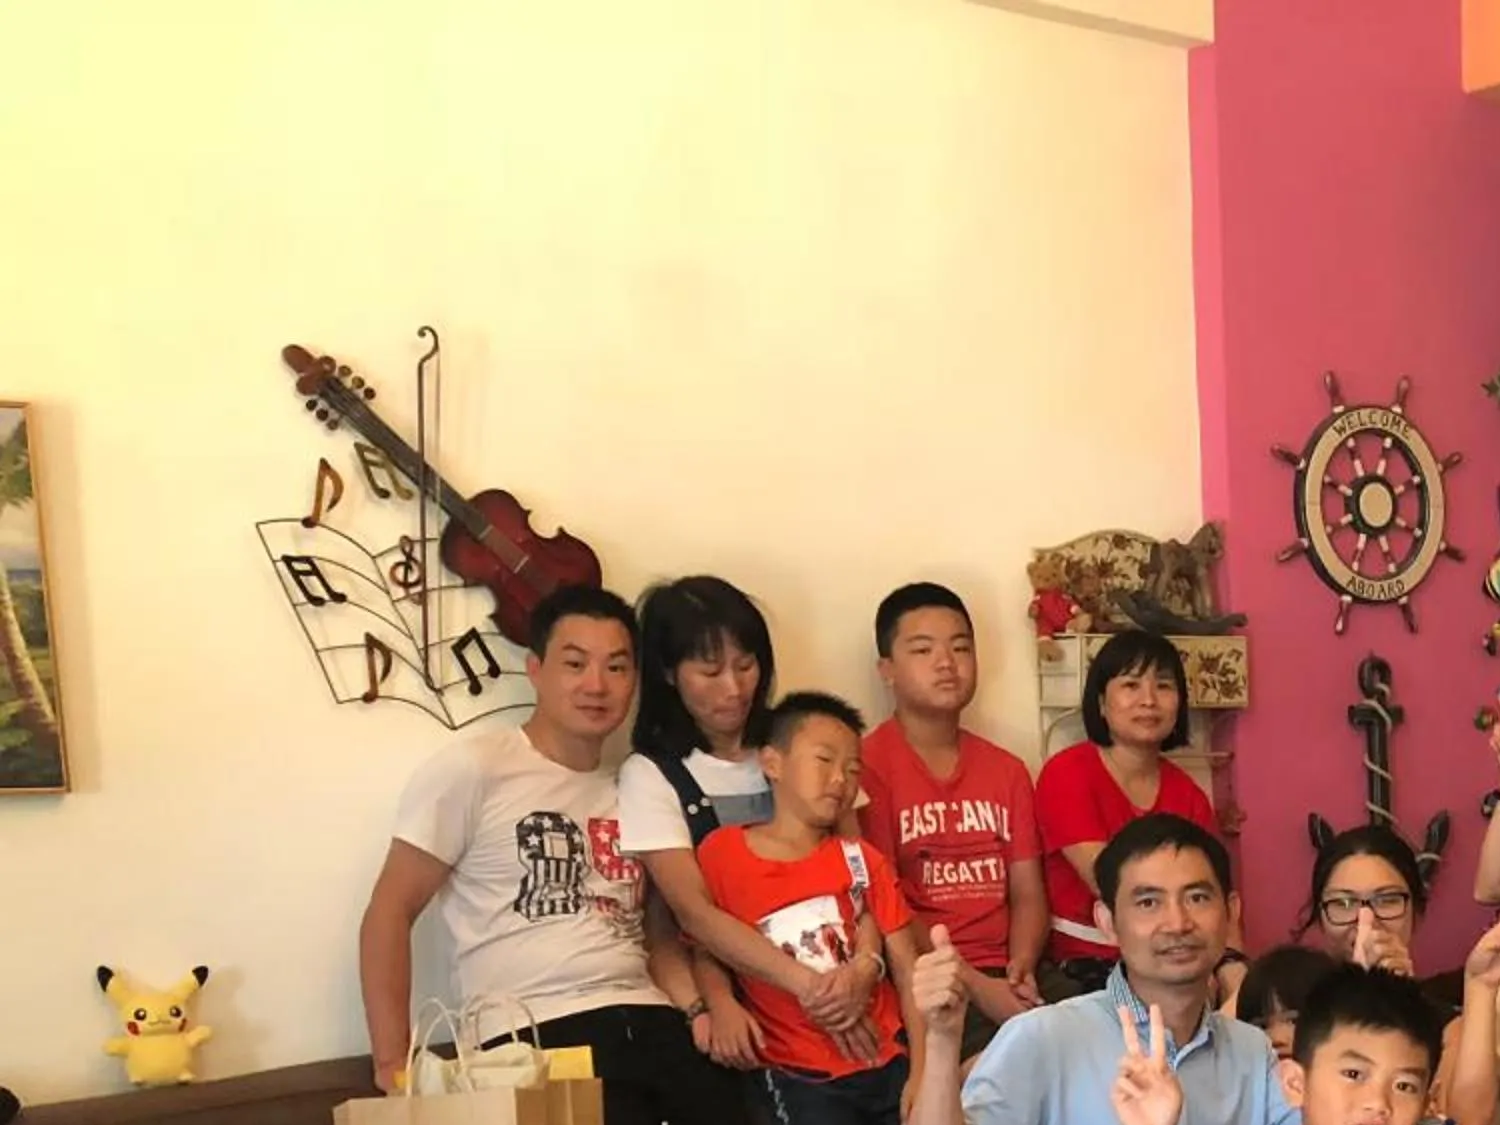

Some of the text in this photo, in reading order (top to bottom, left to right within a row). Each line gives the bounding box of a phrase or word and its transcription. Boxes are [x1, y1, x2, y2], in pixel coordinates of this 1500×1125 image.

[1332, 411, 1410, 438] WELCOME
[1345, 575, 1405, 599] ABOARD
[900, 801, 947, 844] EAST
